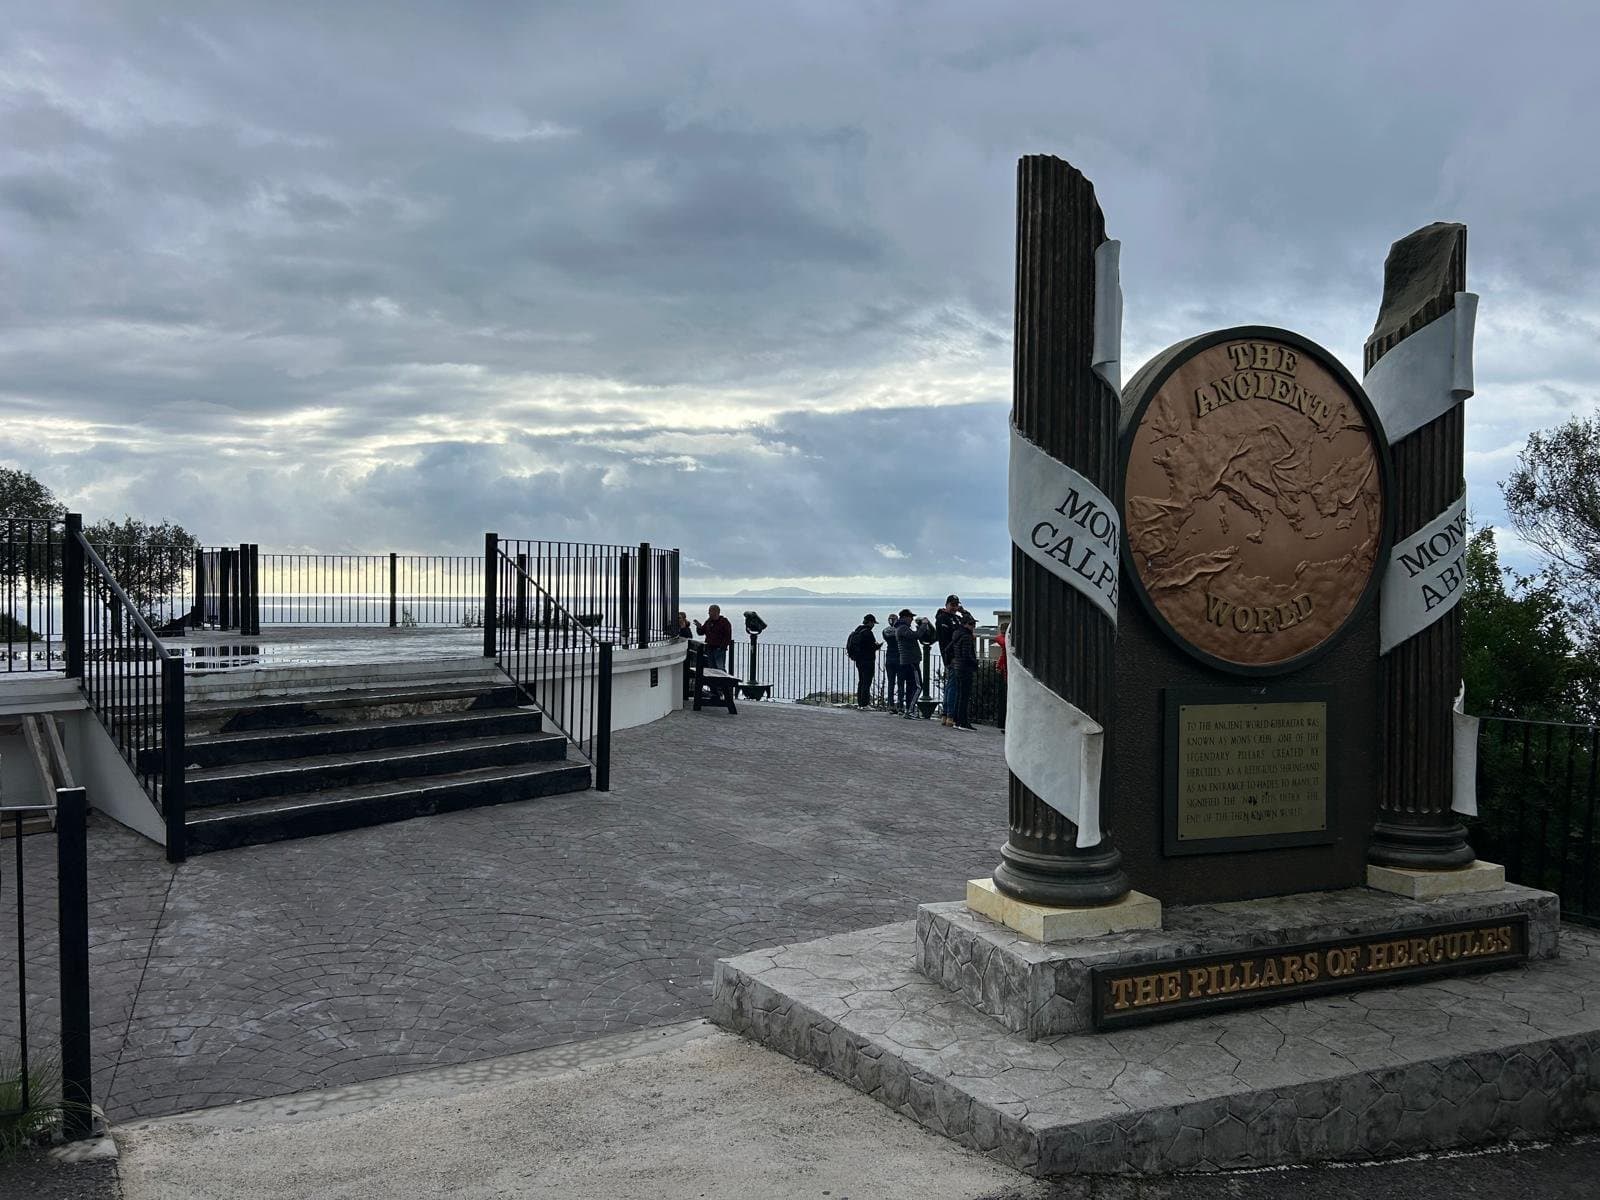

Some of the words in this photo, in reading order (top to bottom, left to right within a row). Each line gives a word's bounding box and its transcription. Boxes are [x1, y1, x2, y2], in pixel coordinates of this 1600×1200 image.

[1228, 343, 1299, 378] THE
[1195, 371, 1334, 426] ANCIENT
[1055, 488, 1120, 560] MON
[1206, 592, 1312, 633] WORLD
[1187, 735, 1215, 746] KNOWN
[1214, 719, 1244, 731] ANCIENT
[1245, 719, 1270, 730] WORLD
[1186, 750, 1230, 762] LEGENDARY
[1112, 972, 1182, 1010] THE
[1188, 952, 1320, 999] PILLARS
[1326, 946, 1361, 977] OF
[1367, 926, 1512, 972] HERCULES
